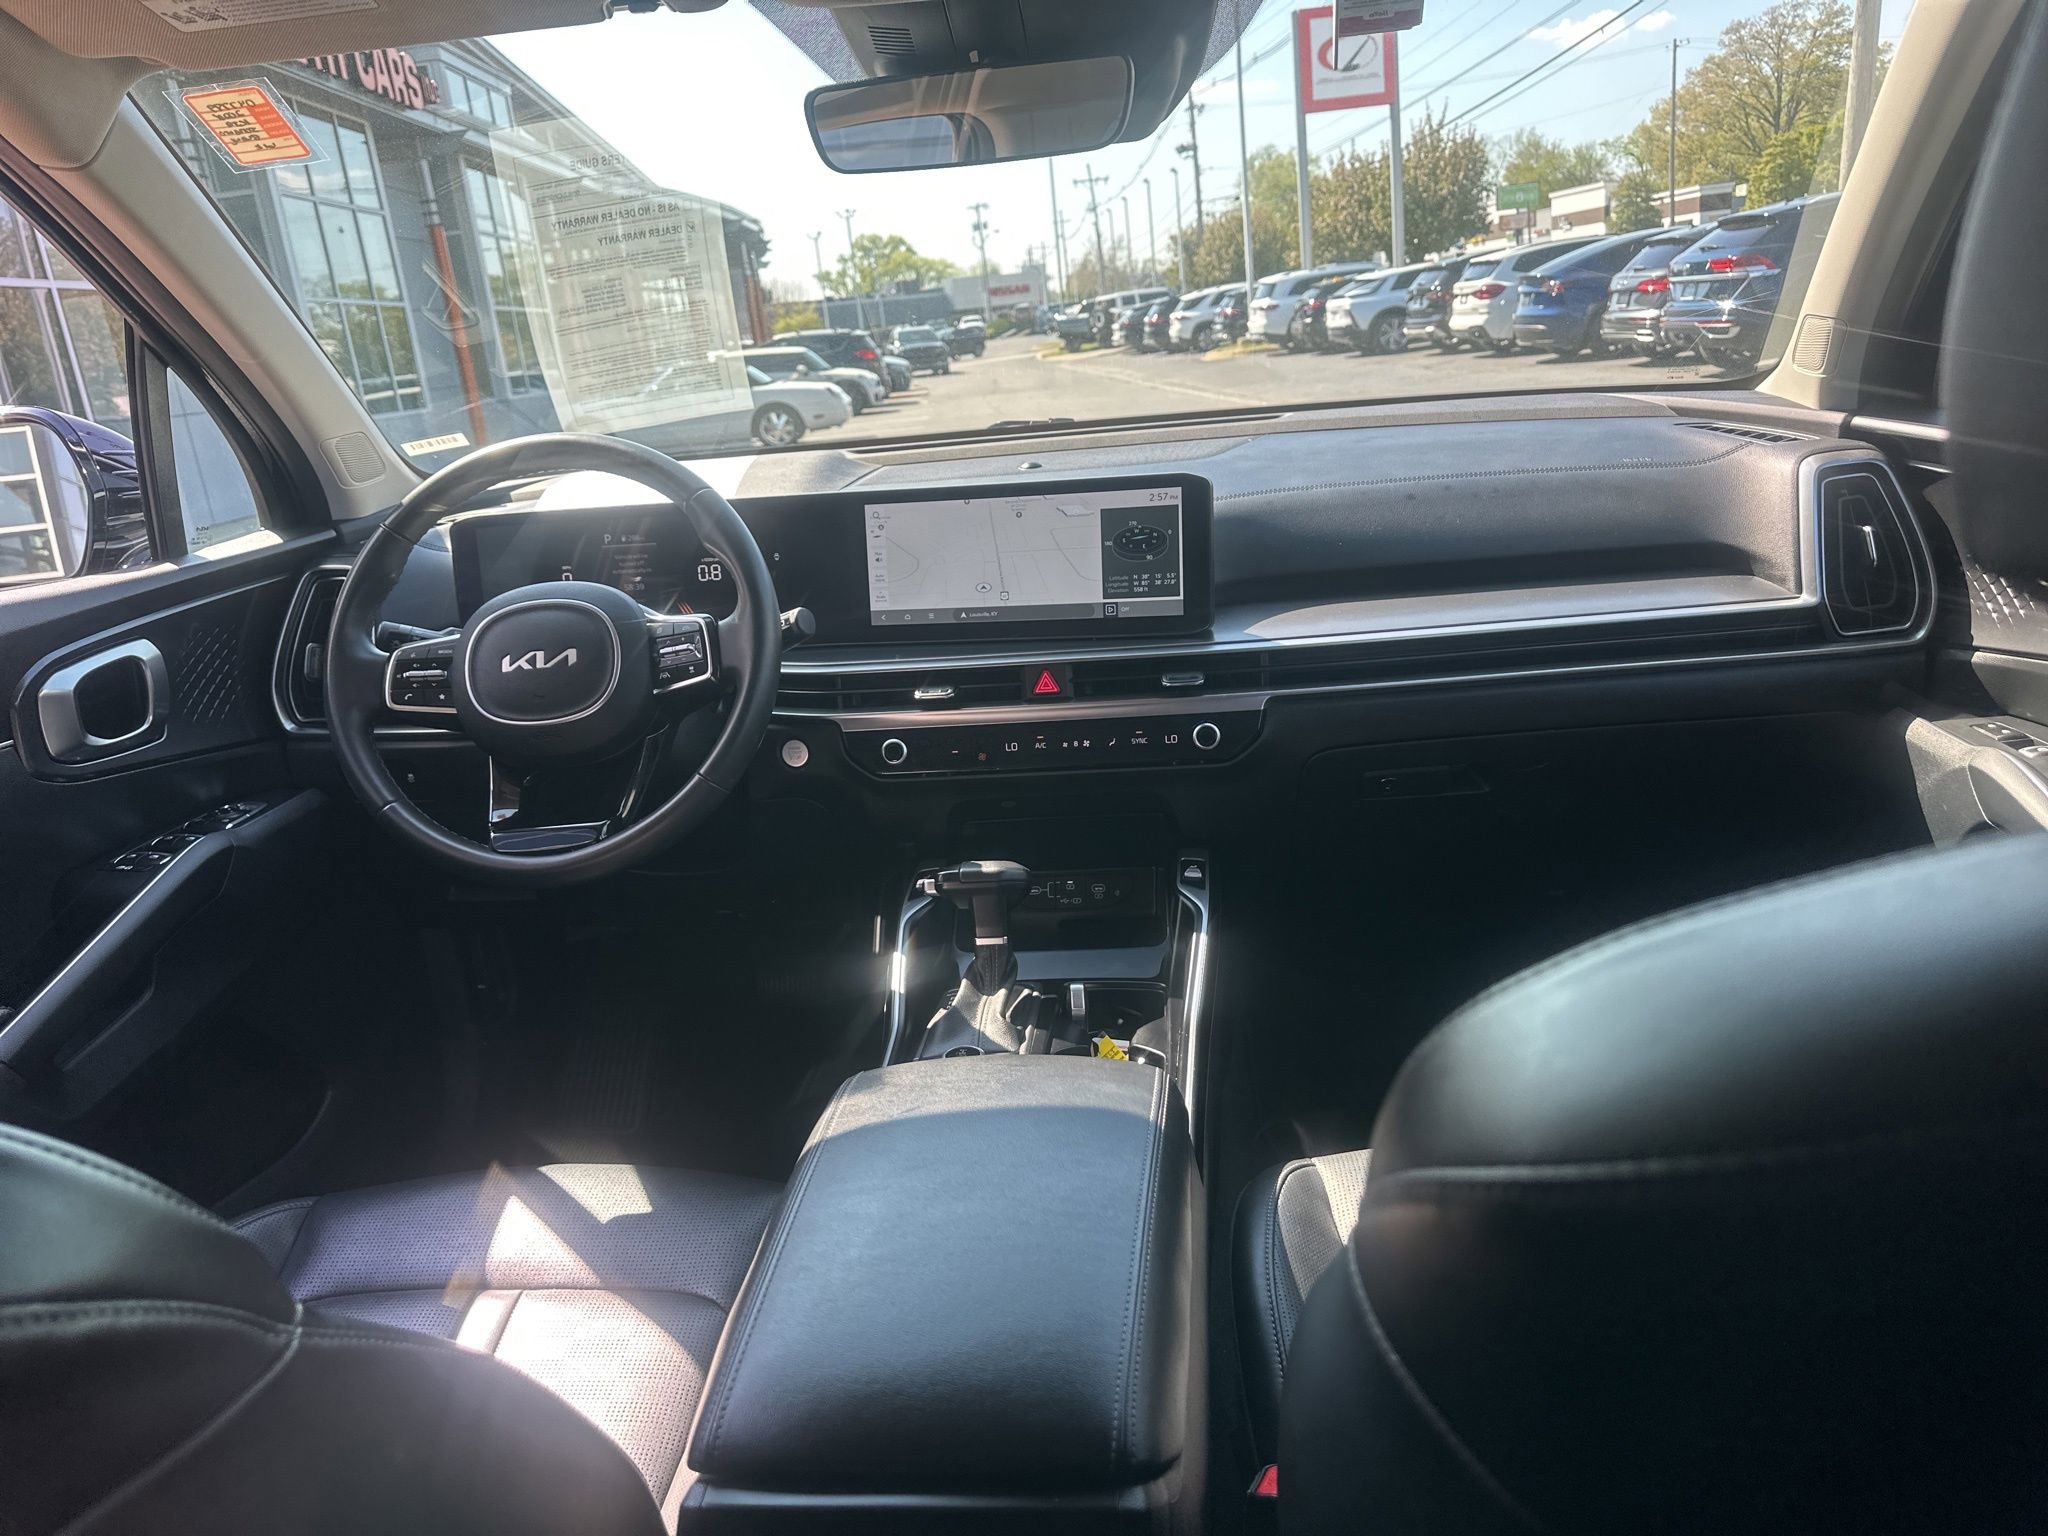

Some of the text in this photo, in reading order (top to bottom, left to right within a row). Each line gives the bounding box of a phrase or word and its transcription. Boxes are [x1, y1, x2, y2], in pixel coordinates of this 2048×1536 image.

[354, 48, 425, 110] CARS
[1149, 493, 1169, 502] 2:57
[604, 534, 612, 544] P
[697, 564, 722, 581] 0.8
[501, 648, 577, 673] KIA
[1131, 737, 1148, 745] SYNC
[1164, 734, 1178, 744] LO
[1005, 742, 1018, 752] LO
